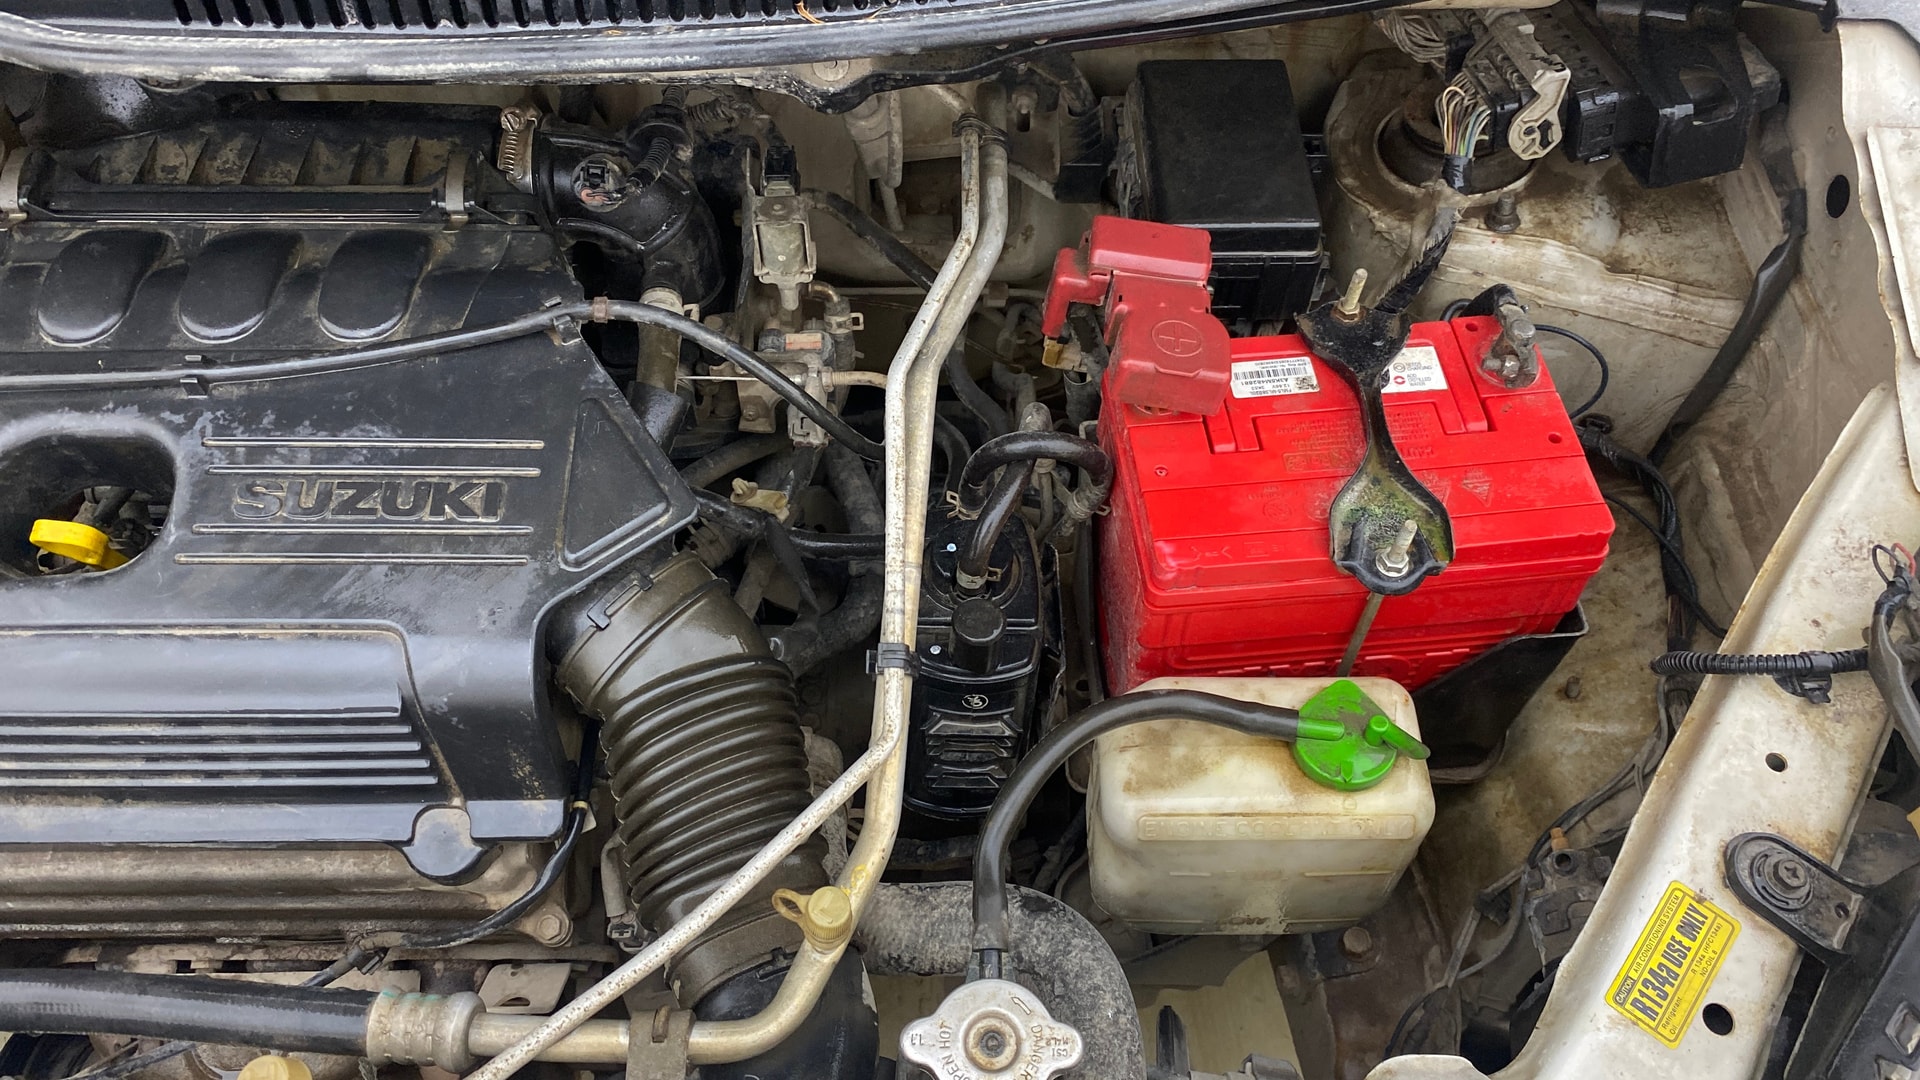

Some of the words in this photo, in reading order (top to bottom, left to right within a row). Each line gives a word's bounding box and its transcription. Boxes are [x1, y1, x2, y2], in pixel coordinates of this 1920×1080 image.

[231, 477, 507, 522] SUZUKI
[1675, 902, 1709, 943] ONLY
[1616, 977, 1635, 1003] CAUTION
[1633, 962, 1643, 974] AIR
[1639, 917, 1667, 962] CONDITIONING
[1664, 894, 1680, 921] SYSTEM
[1661, 935, 1692, 969] USE
[1630, 961, 1681, 1023] R134a
[1661, 996, 1682, 1030] Refrigerant
[938, 1020, 952, 1050] HOT
[1020, 1024, 1044, 1080] DANGER
[1052, 1048, 1069, 1057] CSI
